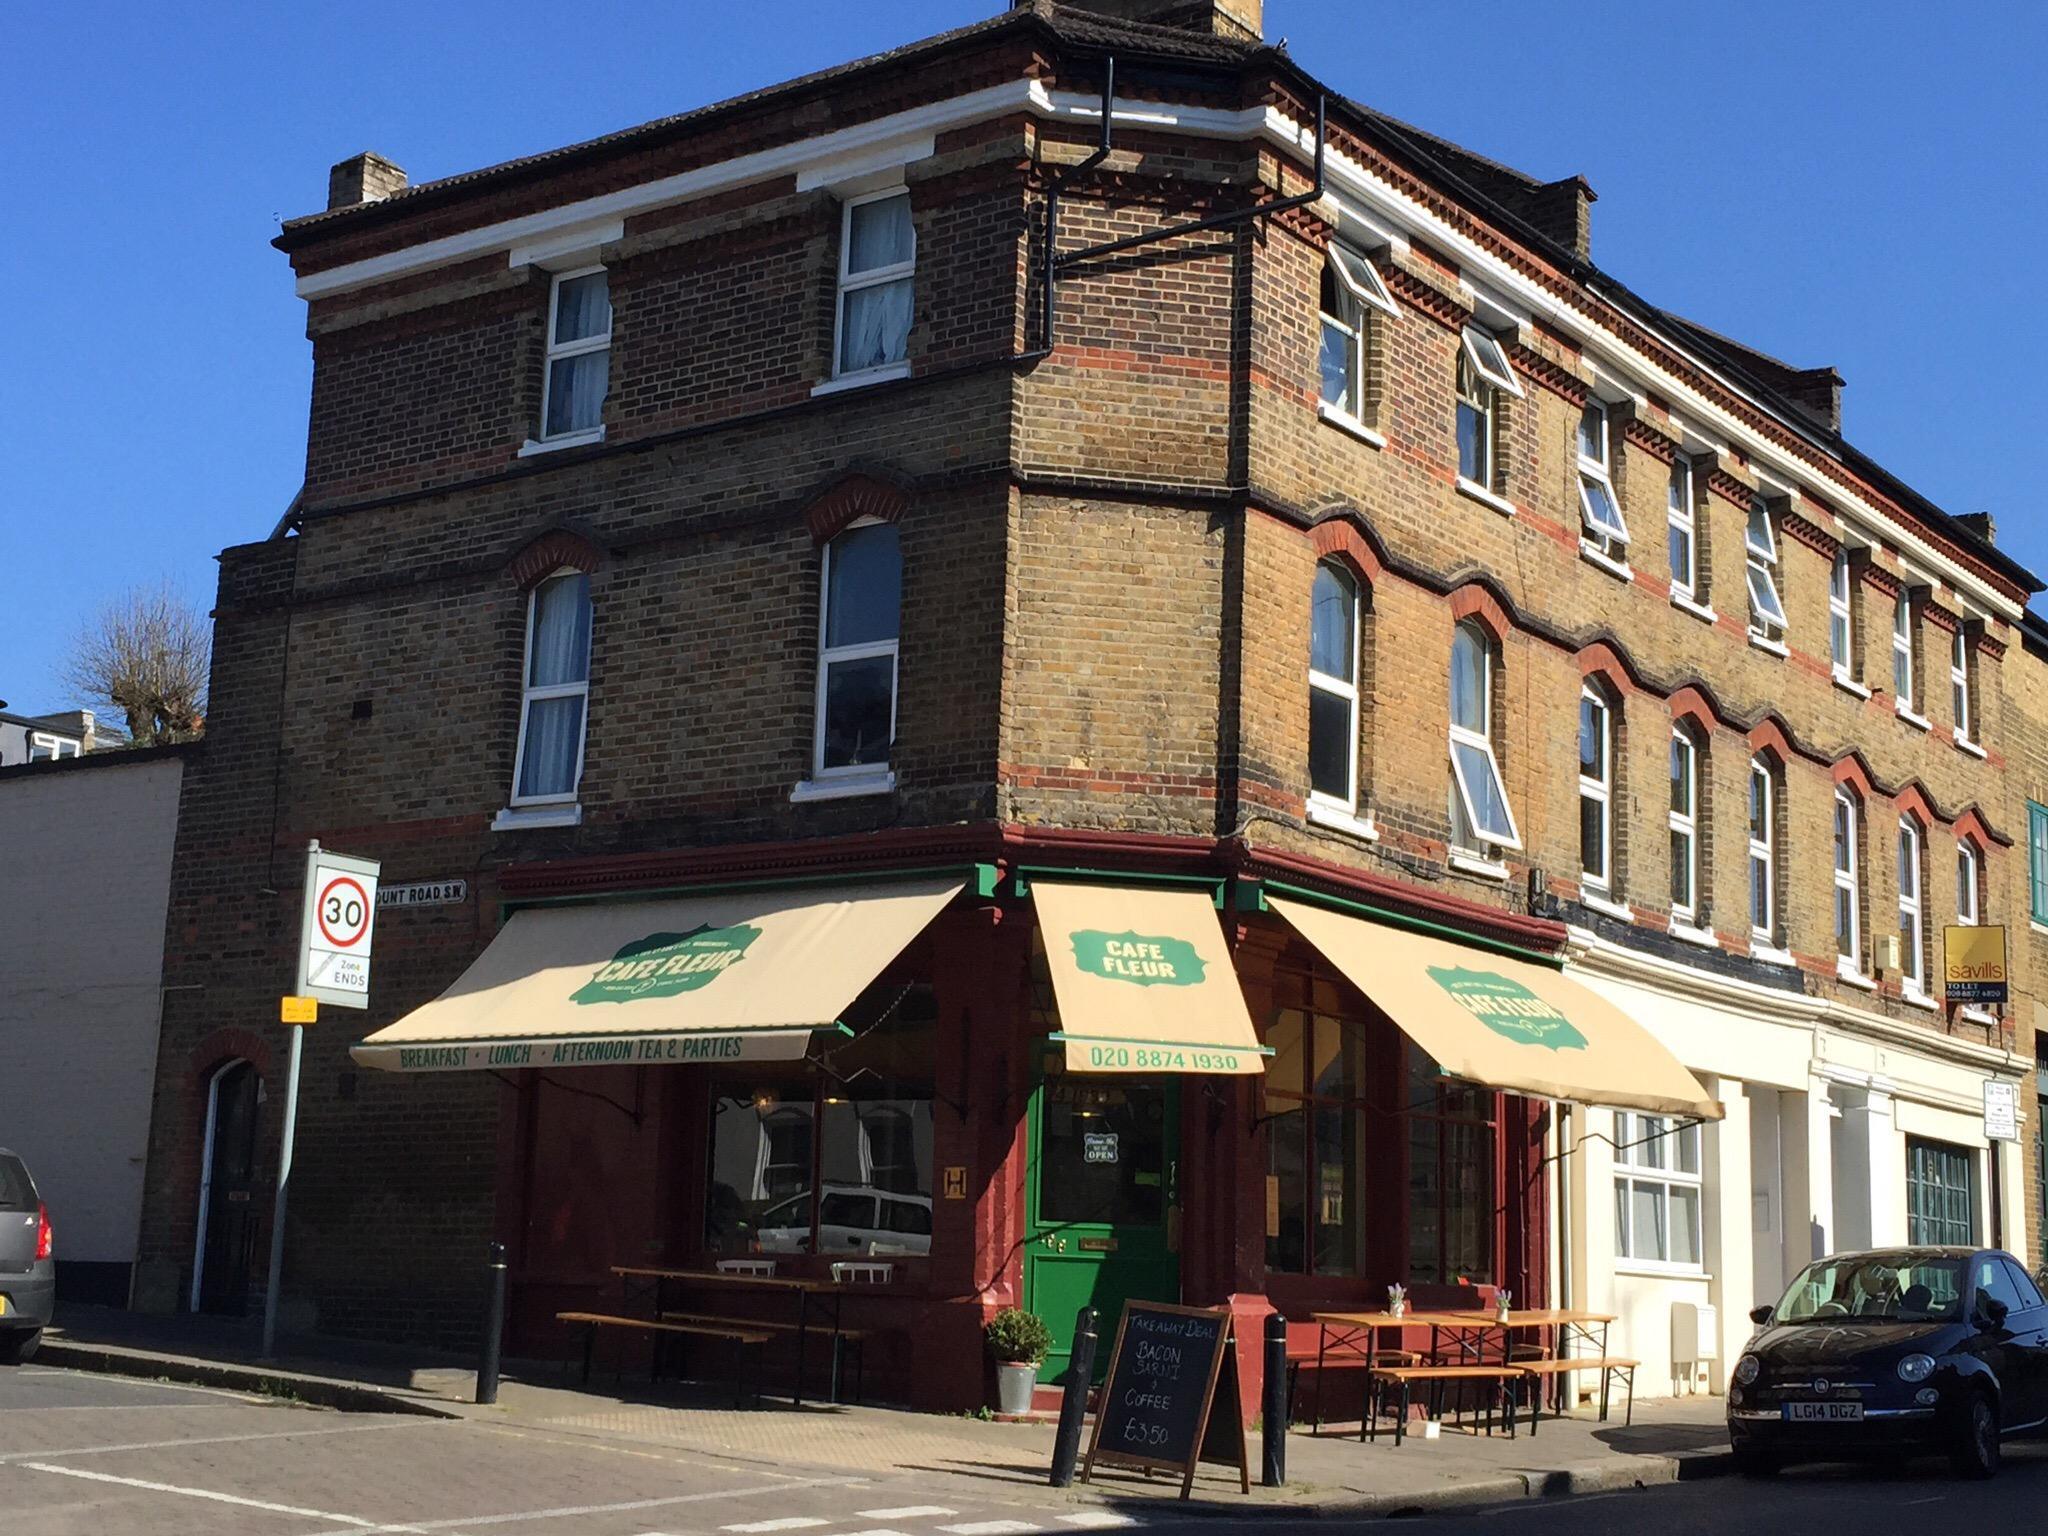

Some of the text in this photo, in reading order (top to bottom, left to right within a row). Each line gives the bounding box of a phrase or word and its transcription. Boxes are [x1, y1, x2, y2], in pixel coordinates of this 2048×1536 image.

[377, 889, 406, 904] OUNT
[409, 886, 440, 902] ROAD
[325, 897, 362, 927] 30
[1105, 940, 1164, 960] CAFE
[341, 960, 361, 970] Zone
[595, 959, 666, 983] CAFE
[655, 949, 742, 977] FLEUR
[1102, 956, 1177, 978] FLEUR
[1950, 962, 2003, 979] savills
[334, 972, 366, 986] ENDS
[401, 1037, 743, 1067] BREAKFAST LUNCH AFTERNOON TEA & PARTIES
[1091, 1048, 1238, 1070] 020 8874 1930
[1088, 1151, 1114, 1159] OPEN
[1130, 1315, 1216, 1339] TAKEAWAY DEAL
[1136, 1341, 1181, 1364] BACON
[1133, 1359, 1180, 1381] SARNI
[1125, 1388, 1171, 1411] COFFEE
[1794, 1403, 1858, 1418] LG14 DGZ
